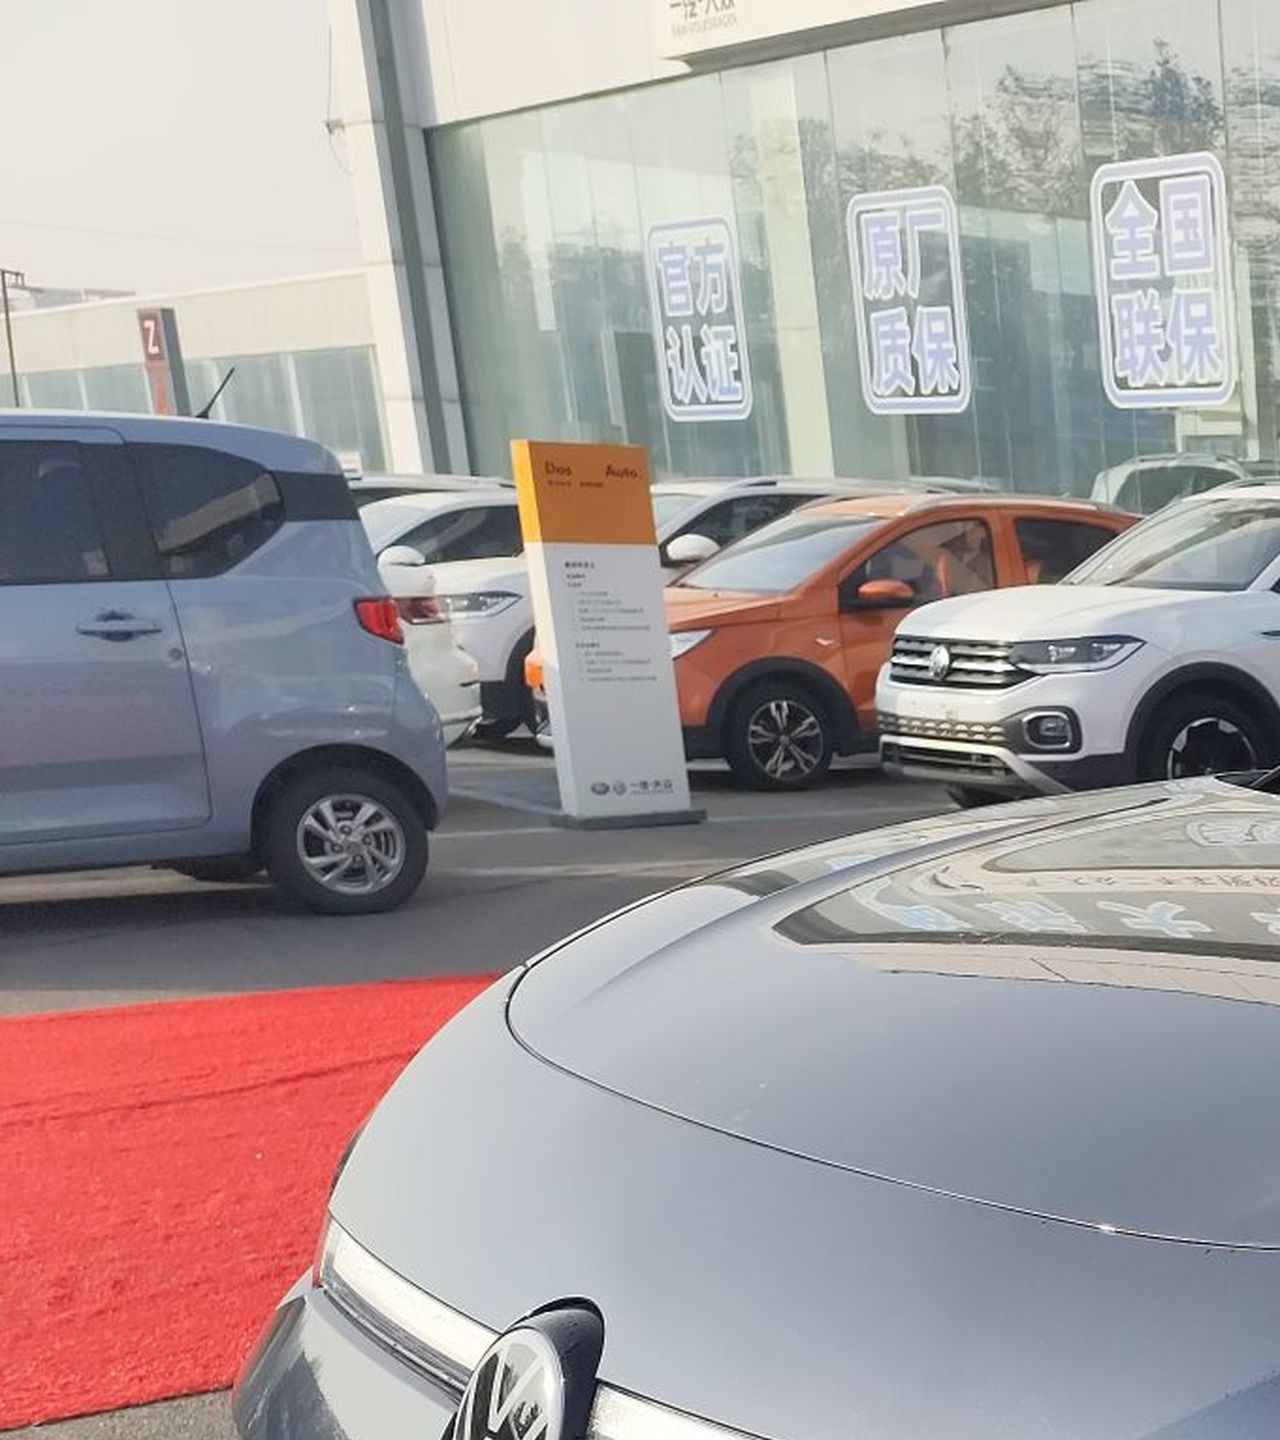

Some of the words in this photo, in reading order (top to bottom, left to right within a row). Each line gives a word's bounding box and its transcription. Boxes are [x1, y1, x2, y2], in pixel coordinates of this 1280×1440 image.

[860, 203, 951, 299] 原厂
[1107, 175, 1215, 280] 全国
[654, 236, 728, 317] 官方
[664, 324, 742, 405] 认证
[869, 306, 962, 397] 质保
[1111, 288, 1222, 388] 联保
